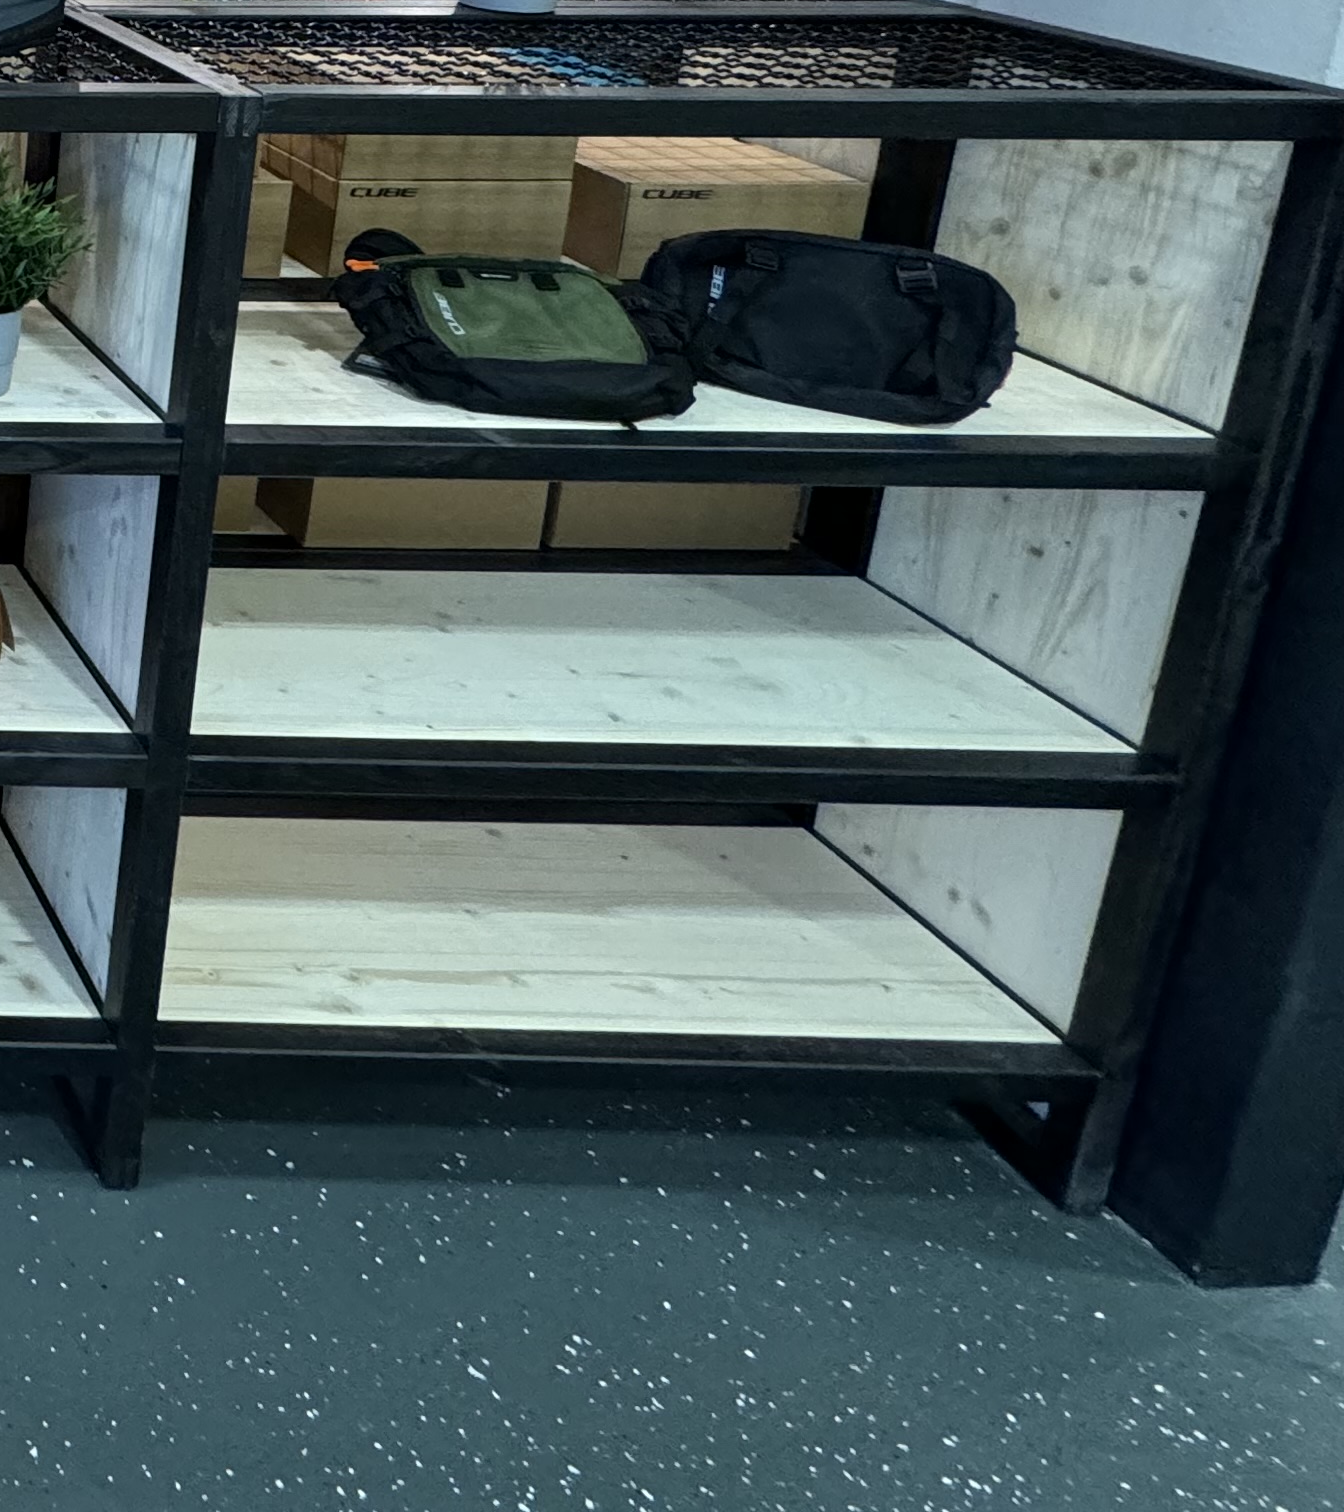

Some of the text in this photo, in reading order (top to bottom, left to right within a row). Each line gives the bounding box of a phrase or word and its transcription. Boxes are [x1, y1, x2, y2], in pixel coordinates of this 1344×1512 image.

[350, 187, 419, 199] CUBE
[642, 189, 714, 200] CUBE
[432, 291, 466, 336] CUBE
